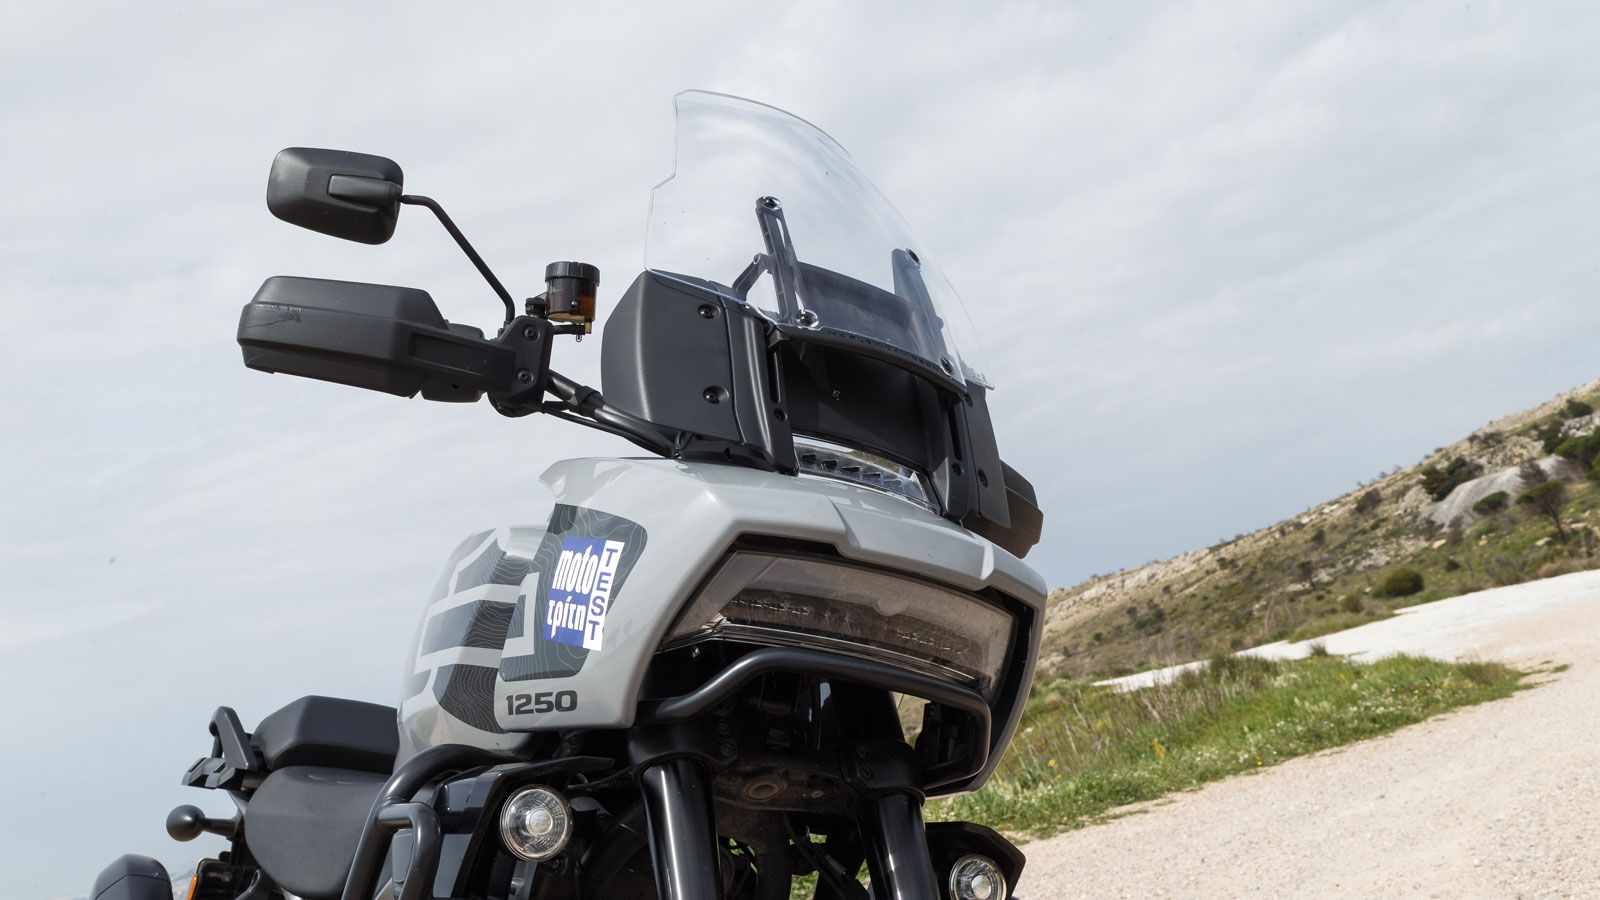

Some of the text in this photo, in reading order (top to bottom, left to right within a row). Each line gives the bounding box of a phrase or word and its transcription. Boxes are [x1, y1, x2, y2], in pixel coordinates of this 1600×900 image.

[552, 544, 599, 595] moto
[588, 547, 619, 641] TEST
[505, 690, 578, 716] 1250
